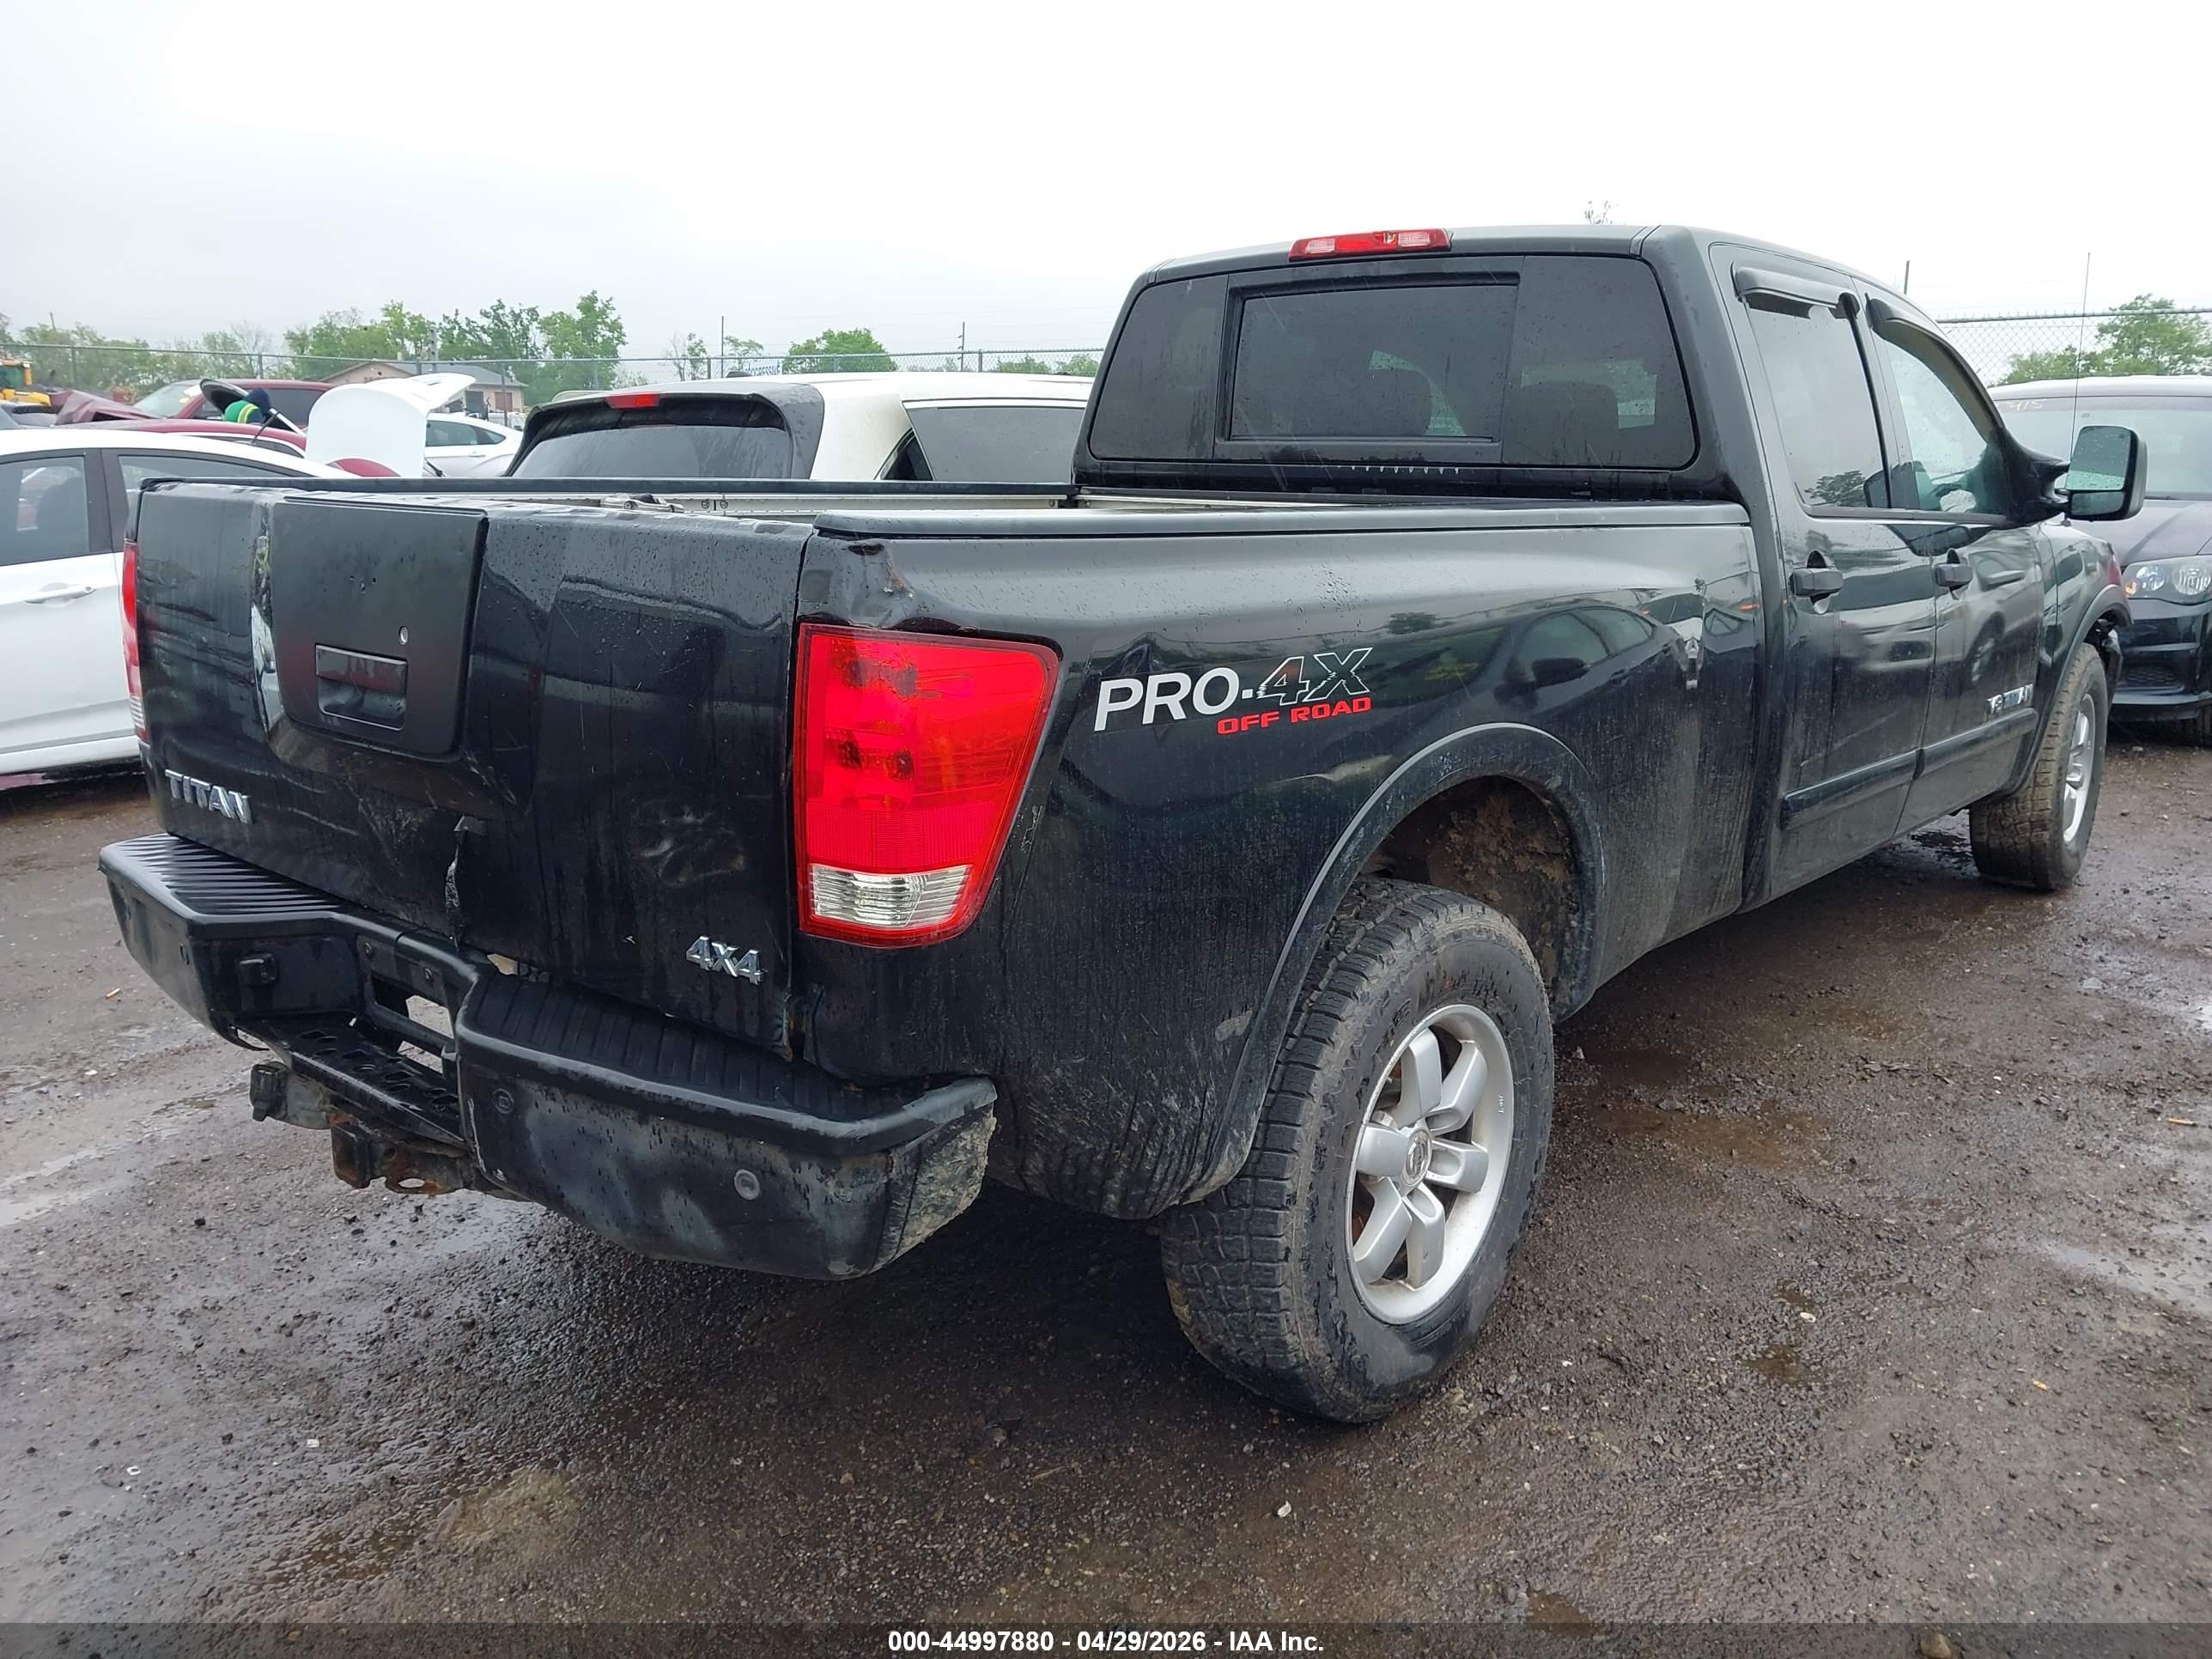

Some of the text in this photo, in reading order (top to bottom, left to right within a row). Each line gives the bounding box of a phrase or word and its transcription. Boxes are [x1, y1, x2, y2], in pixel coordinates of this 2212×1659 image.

[1218, 696, 1372, 735] OFF ROAD
[165, 769, 252, 824] TITAN
[686, 936, 764, 985] 4X4
